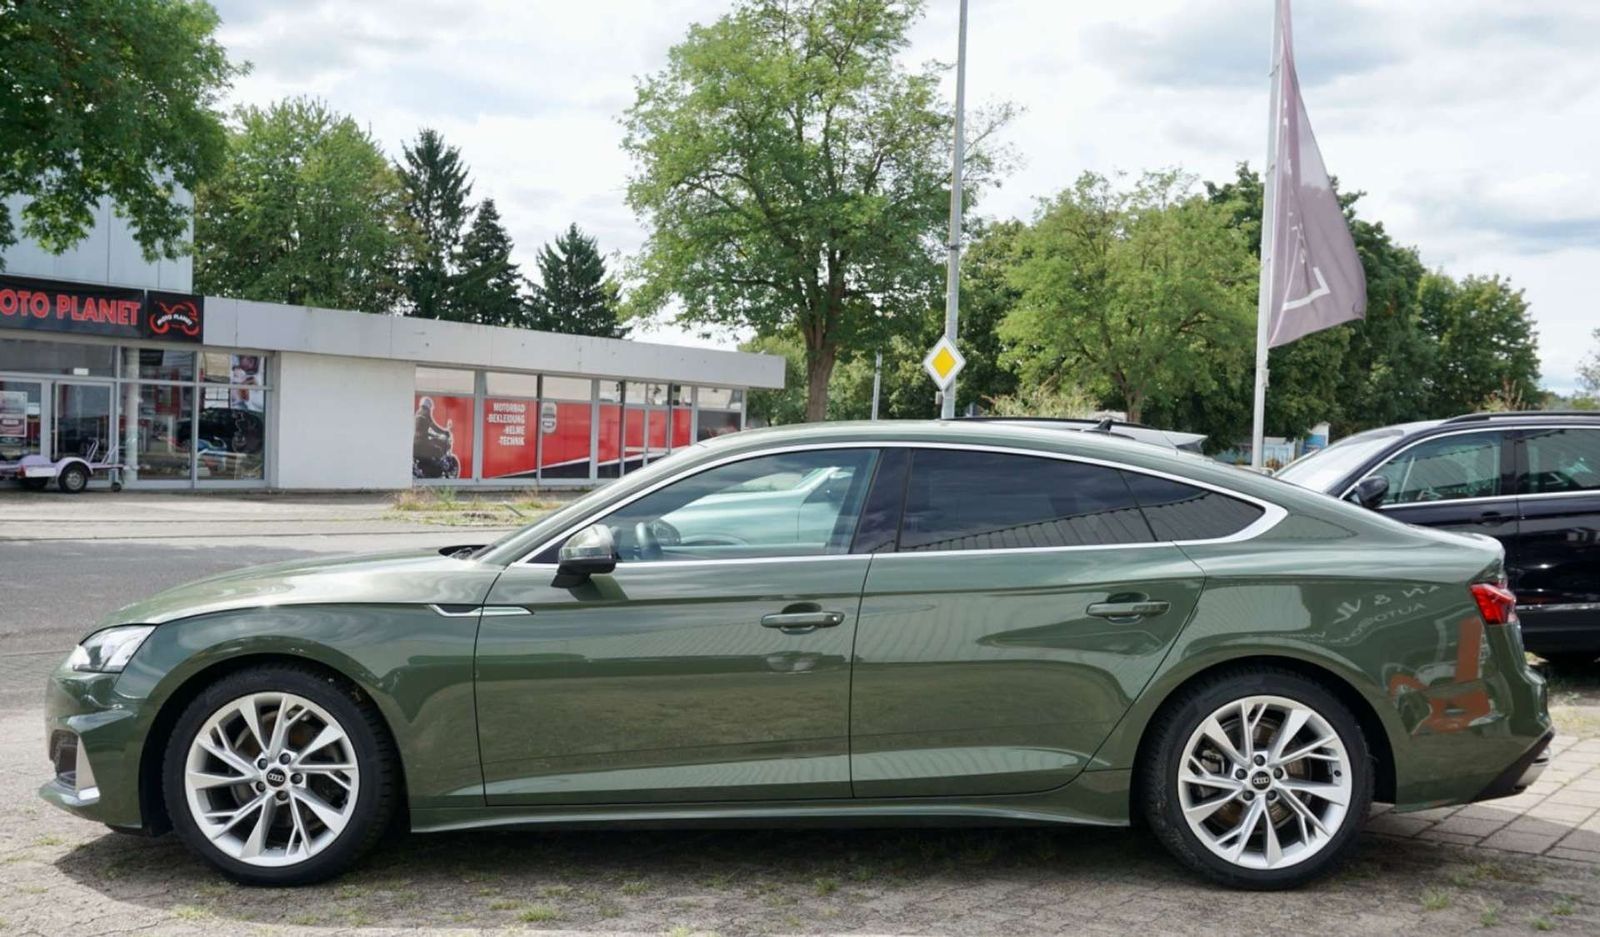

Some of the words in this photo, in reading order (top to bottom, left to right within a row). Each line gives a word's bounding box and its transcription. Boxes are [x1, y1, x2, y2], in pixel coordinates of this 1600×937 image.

[56, 294, 141, 326] PLANET
[157, 315, 172, 325] MOTO
[174, 314, 192, 325] PLANET
